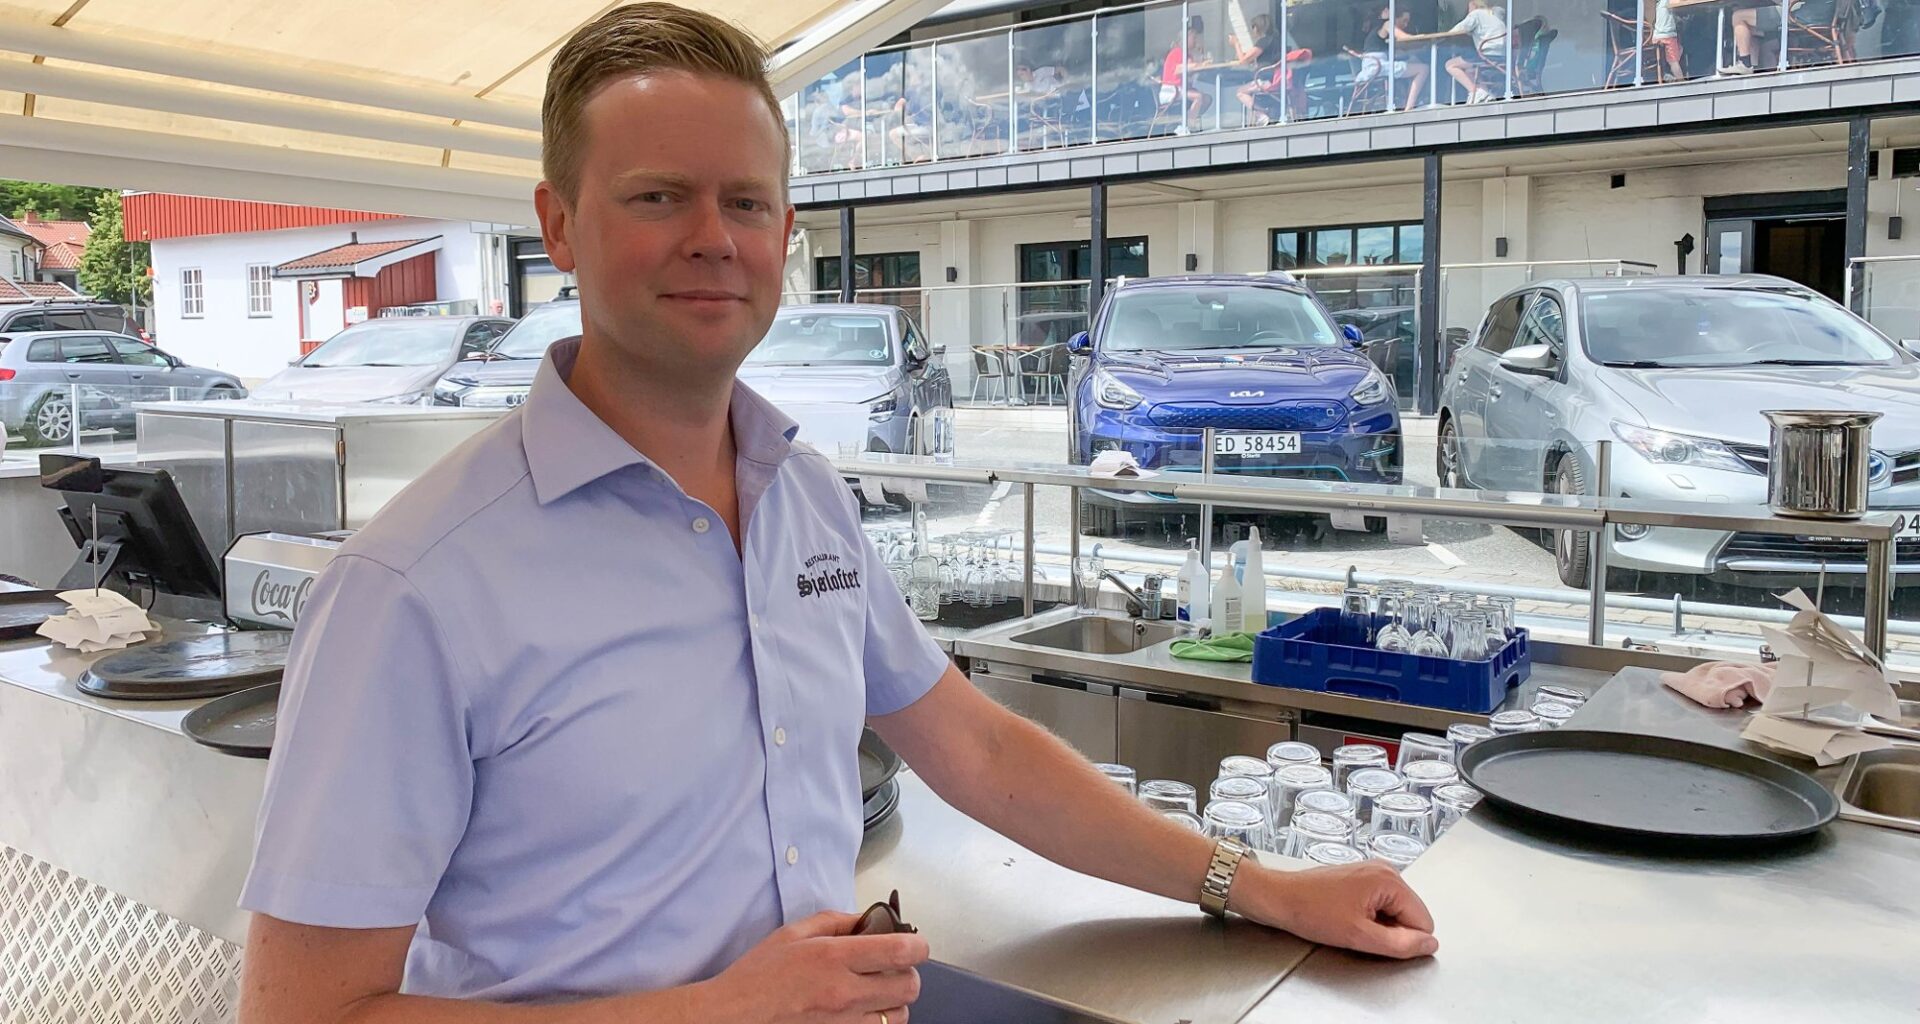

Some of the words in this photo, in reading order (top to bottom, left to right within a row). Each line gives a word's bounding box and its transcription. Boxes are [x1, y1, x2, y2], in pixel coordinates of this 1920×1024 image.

[1215, 437, 1236, 452] ED
[1244, 435, 1297, 452] 58454
[804, 553, 841, 569] RESTAURANT
[796, 567, 861, 599] Sjøloftet
[251, 569, 315, 623] Coca-C
